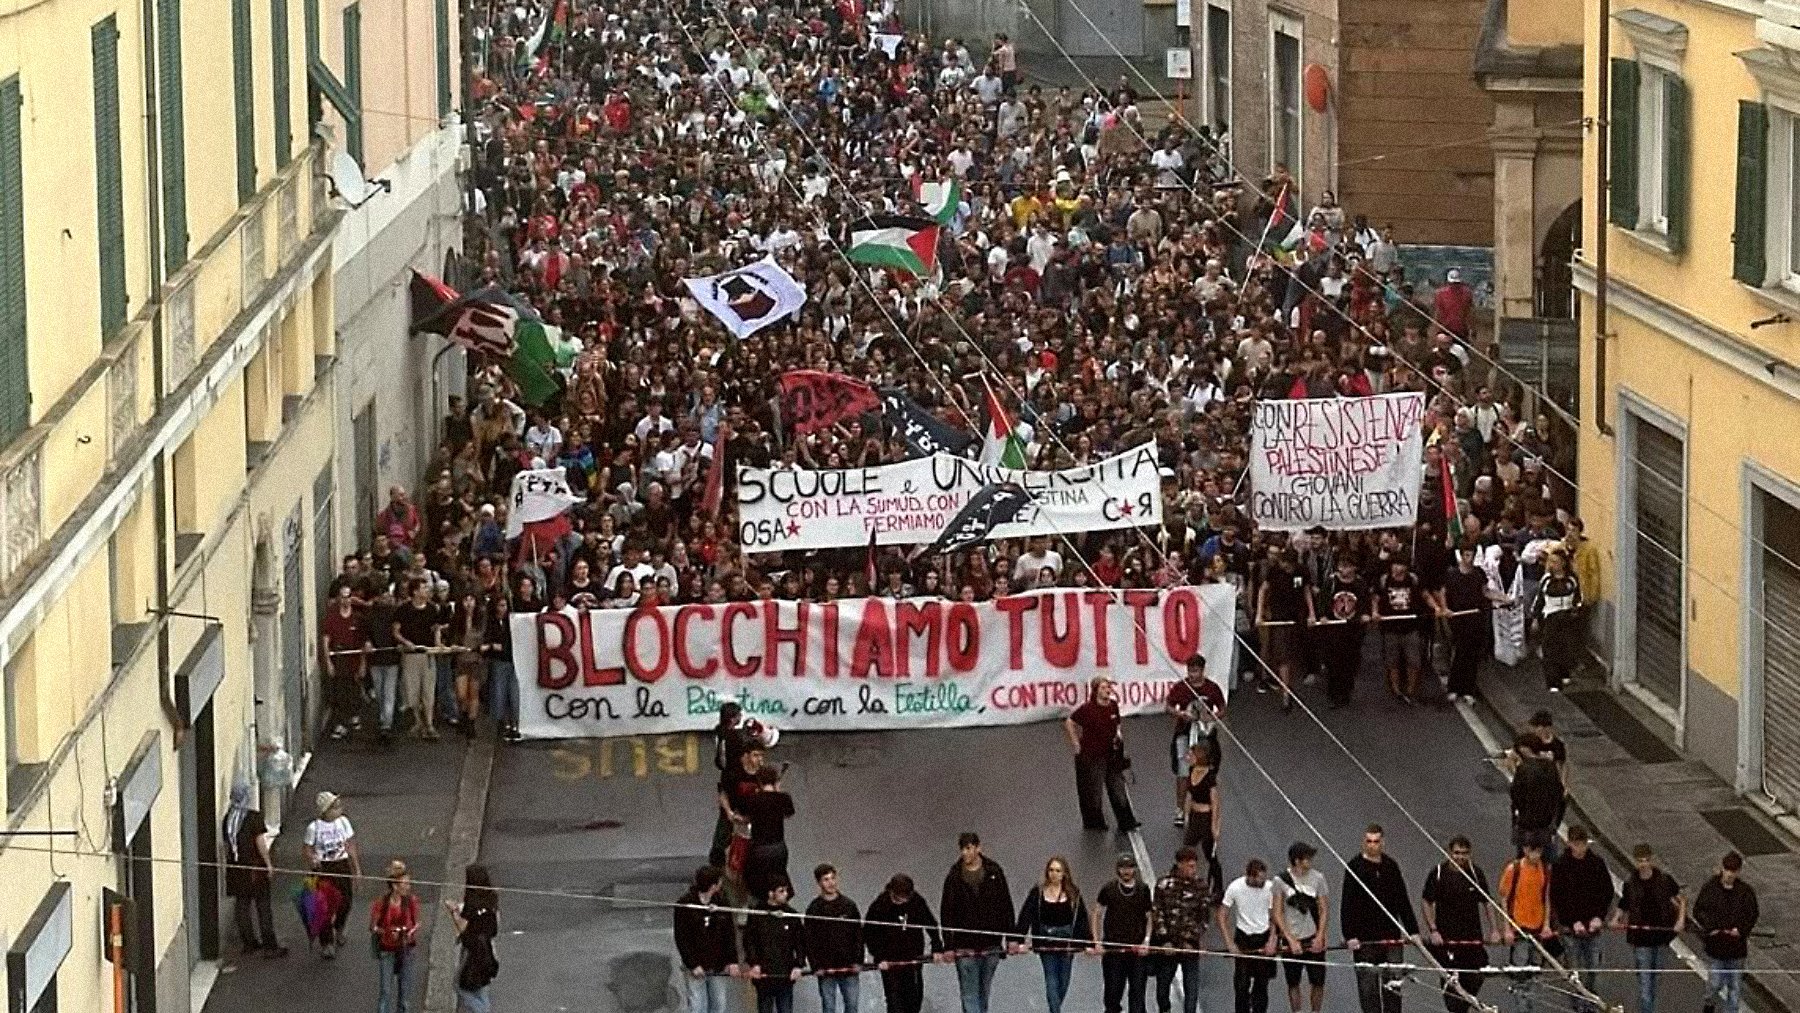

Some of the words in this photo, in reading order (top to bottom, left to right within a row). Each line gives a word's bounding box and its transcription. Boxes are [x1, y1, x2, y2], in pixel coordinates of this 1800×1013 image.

[738, 467, 883, 504] SCUOLE
[1291, 473, 1364, 496] GIOVANI
[786, 501, 829, 519] CON
[836, 498, 862, 516] LA
[927, 492, 960, 511] CON
[1253, 490, 1313, 522] CONTRO
[1320, 494, 1345, 522] LA
[1347, 486, 1413, 520] GUERRA
[740, 518, 788, 546] OSA
[863, 514, 945, 534] FERMIAMO
[536, 598, 980, 690] BLOCCHIAMO
[995, 590, 1201, 671] TUTTO
[632, 686, 670, 719] la
[686, 684, 799, 717] Paletina,
[803, 697, 848, 716] con
[857, 684, 889, 714] la
[990, 681, 1079, 709] CONTRO
